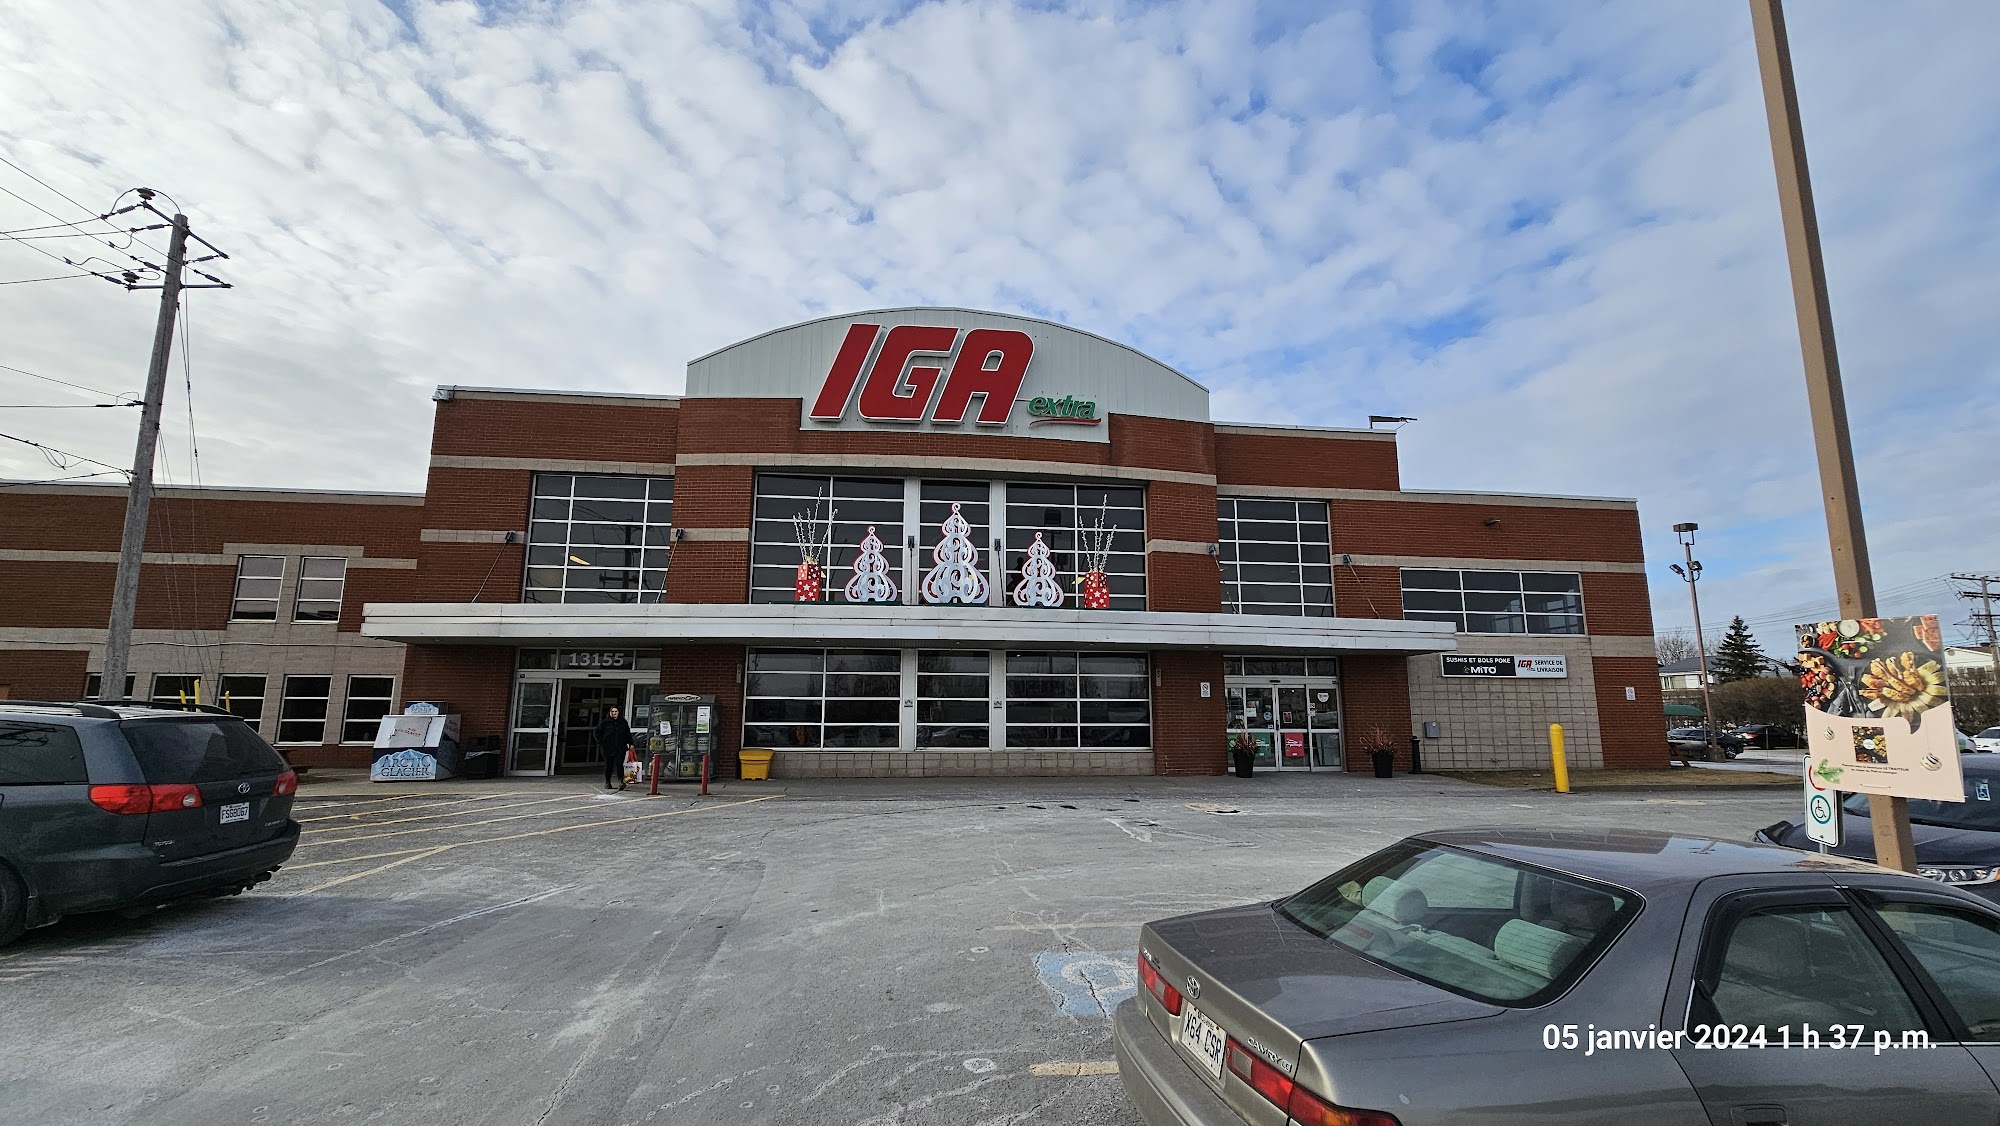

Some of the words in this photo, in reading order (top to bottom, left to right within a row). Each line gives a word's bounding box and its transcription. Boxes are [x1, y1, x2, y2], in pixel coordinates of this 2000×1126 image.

[809, 323, 1034, 426] IGA
[1027, 394, 1096, 419] extra
[569, 652, 625, 667] 13155
[1517, 659, 1533, 668] IGA
[381, 754, 431, 767] ARCTIC
[381, 767, 429, 776] GLACIER
[1184, 1011, 1202, 1044] X64
[1204, 1029, 1223, 1064] CSR
